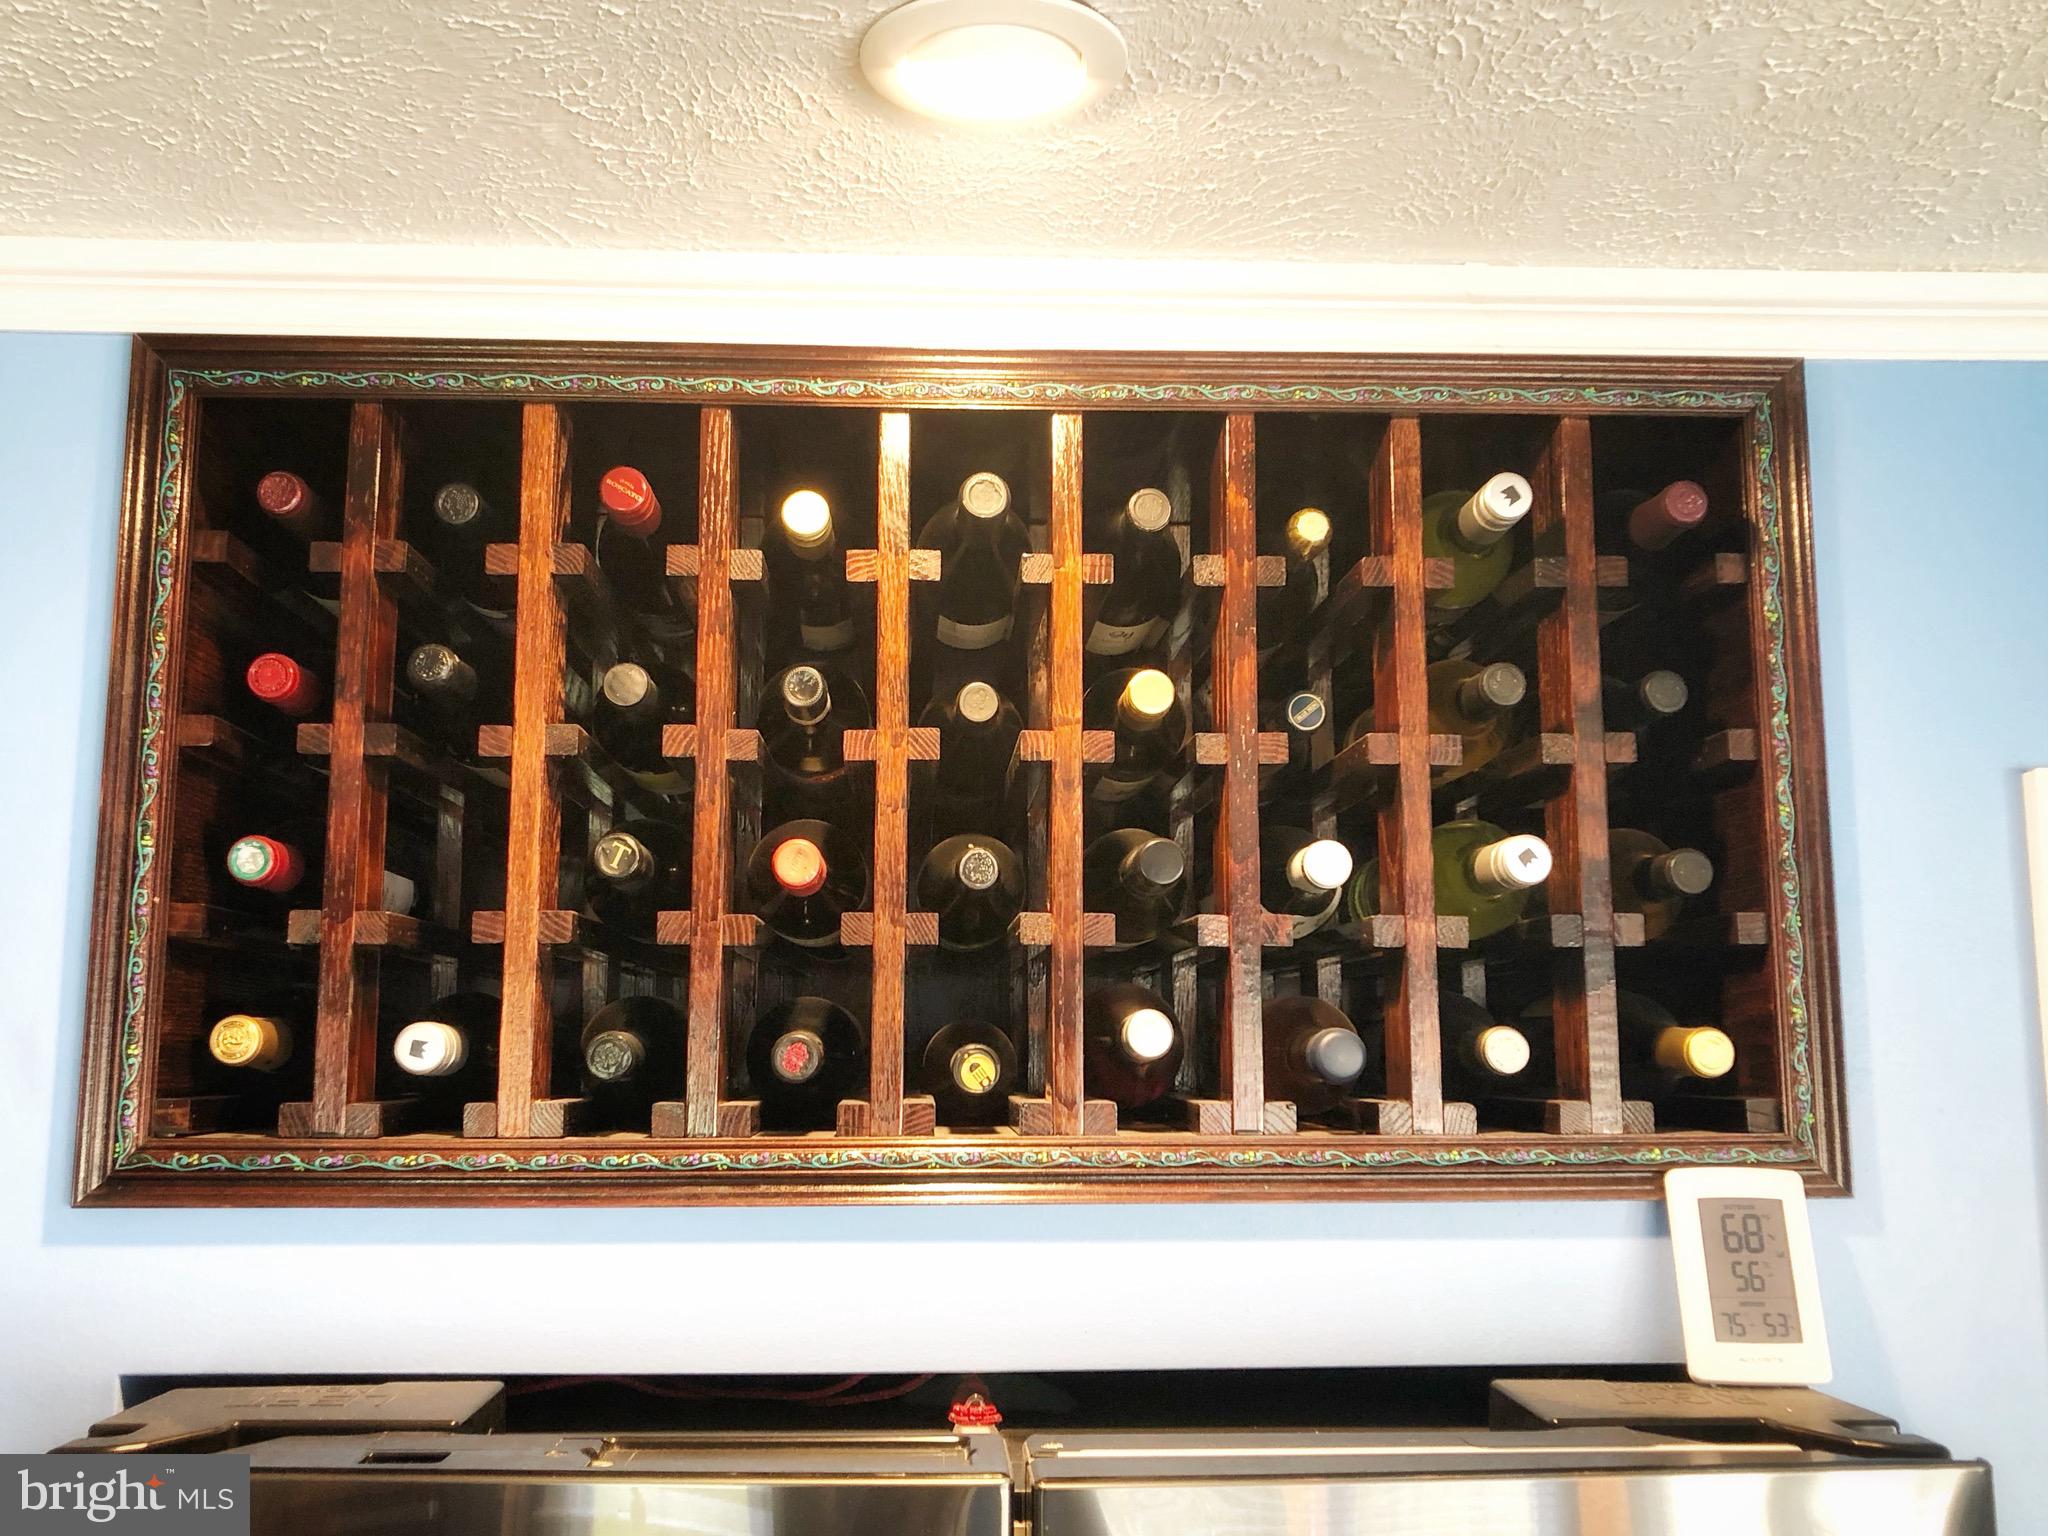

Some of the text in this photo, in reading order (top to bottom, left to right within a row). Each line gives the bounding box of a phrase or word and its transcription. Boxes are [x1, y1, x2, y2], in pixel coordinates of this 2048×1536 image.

[609, 841, 632, 869] T
[1721, 1213, 1765, 1254] 68
[1731, 1260, 1766, 1292] 56
[1721, 1312, 1790, 1338] 75 53
